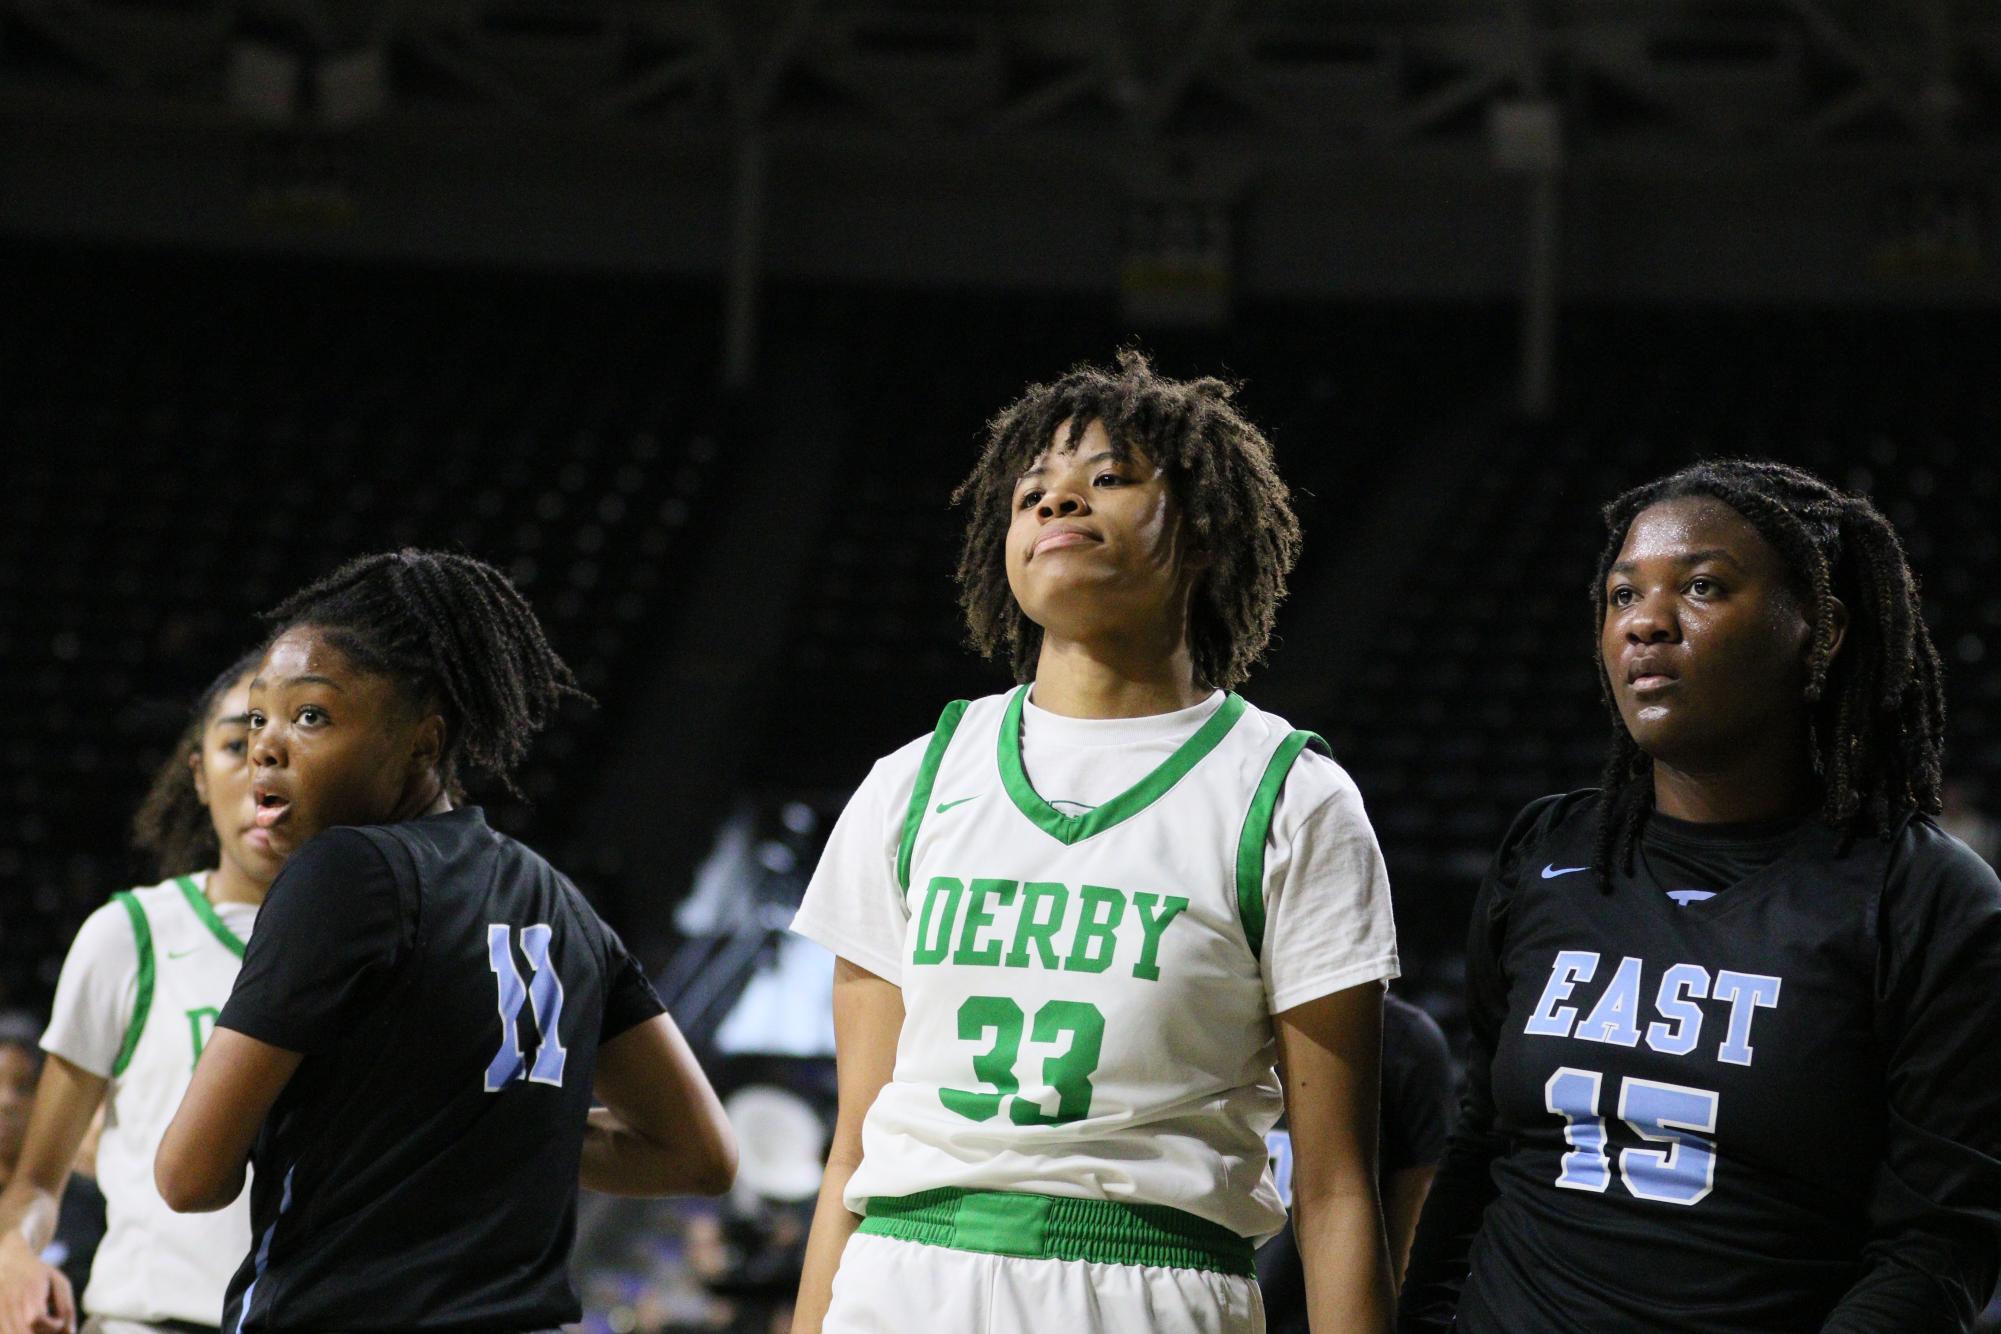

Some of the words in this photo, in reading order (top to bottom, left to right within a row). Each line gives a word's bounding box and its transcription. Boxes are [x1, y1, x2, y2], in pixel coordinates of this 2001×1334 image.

[913, 876, 1189, 982] DERBY
[484, 923, 567, 1092] 11
[938, 996, 1106, 1127] 33
[1524, 951, 1782, 1066] EAST
[1545, 1066, 1720, 1206] 15
